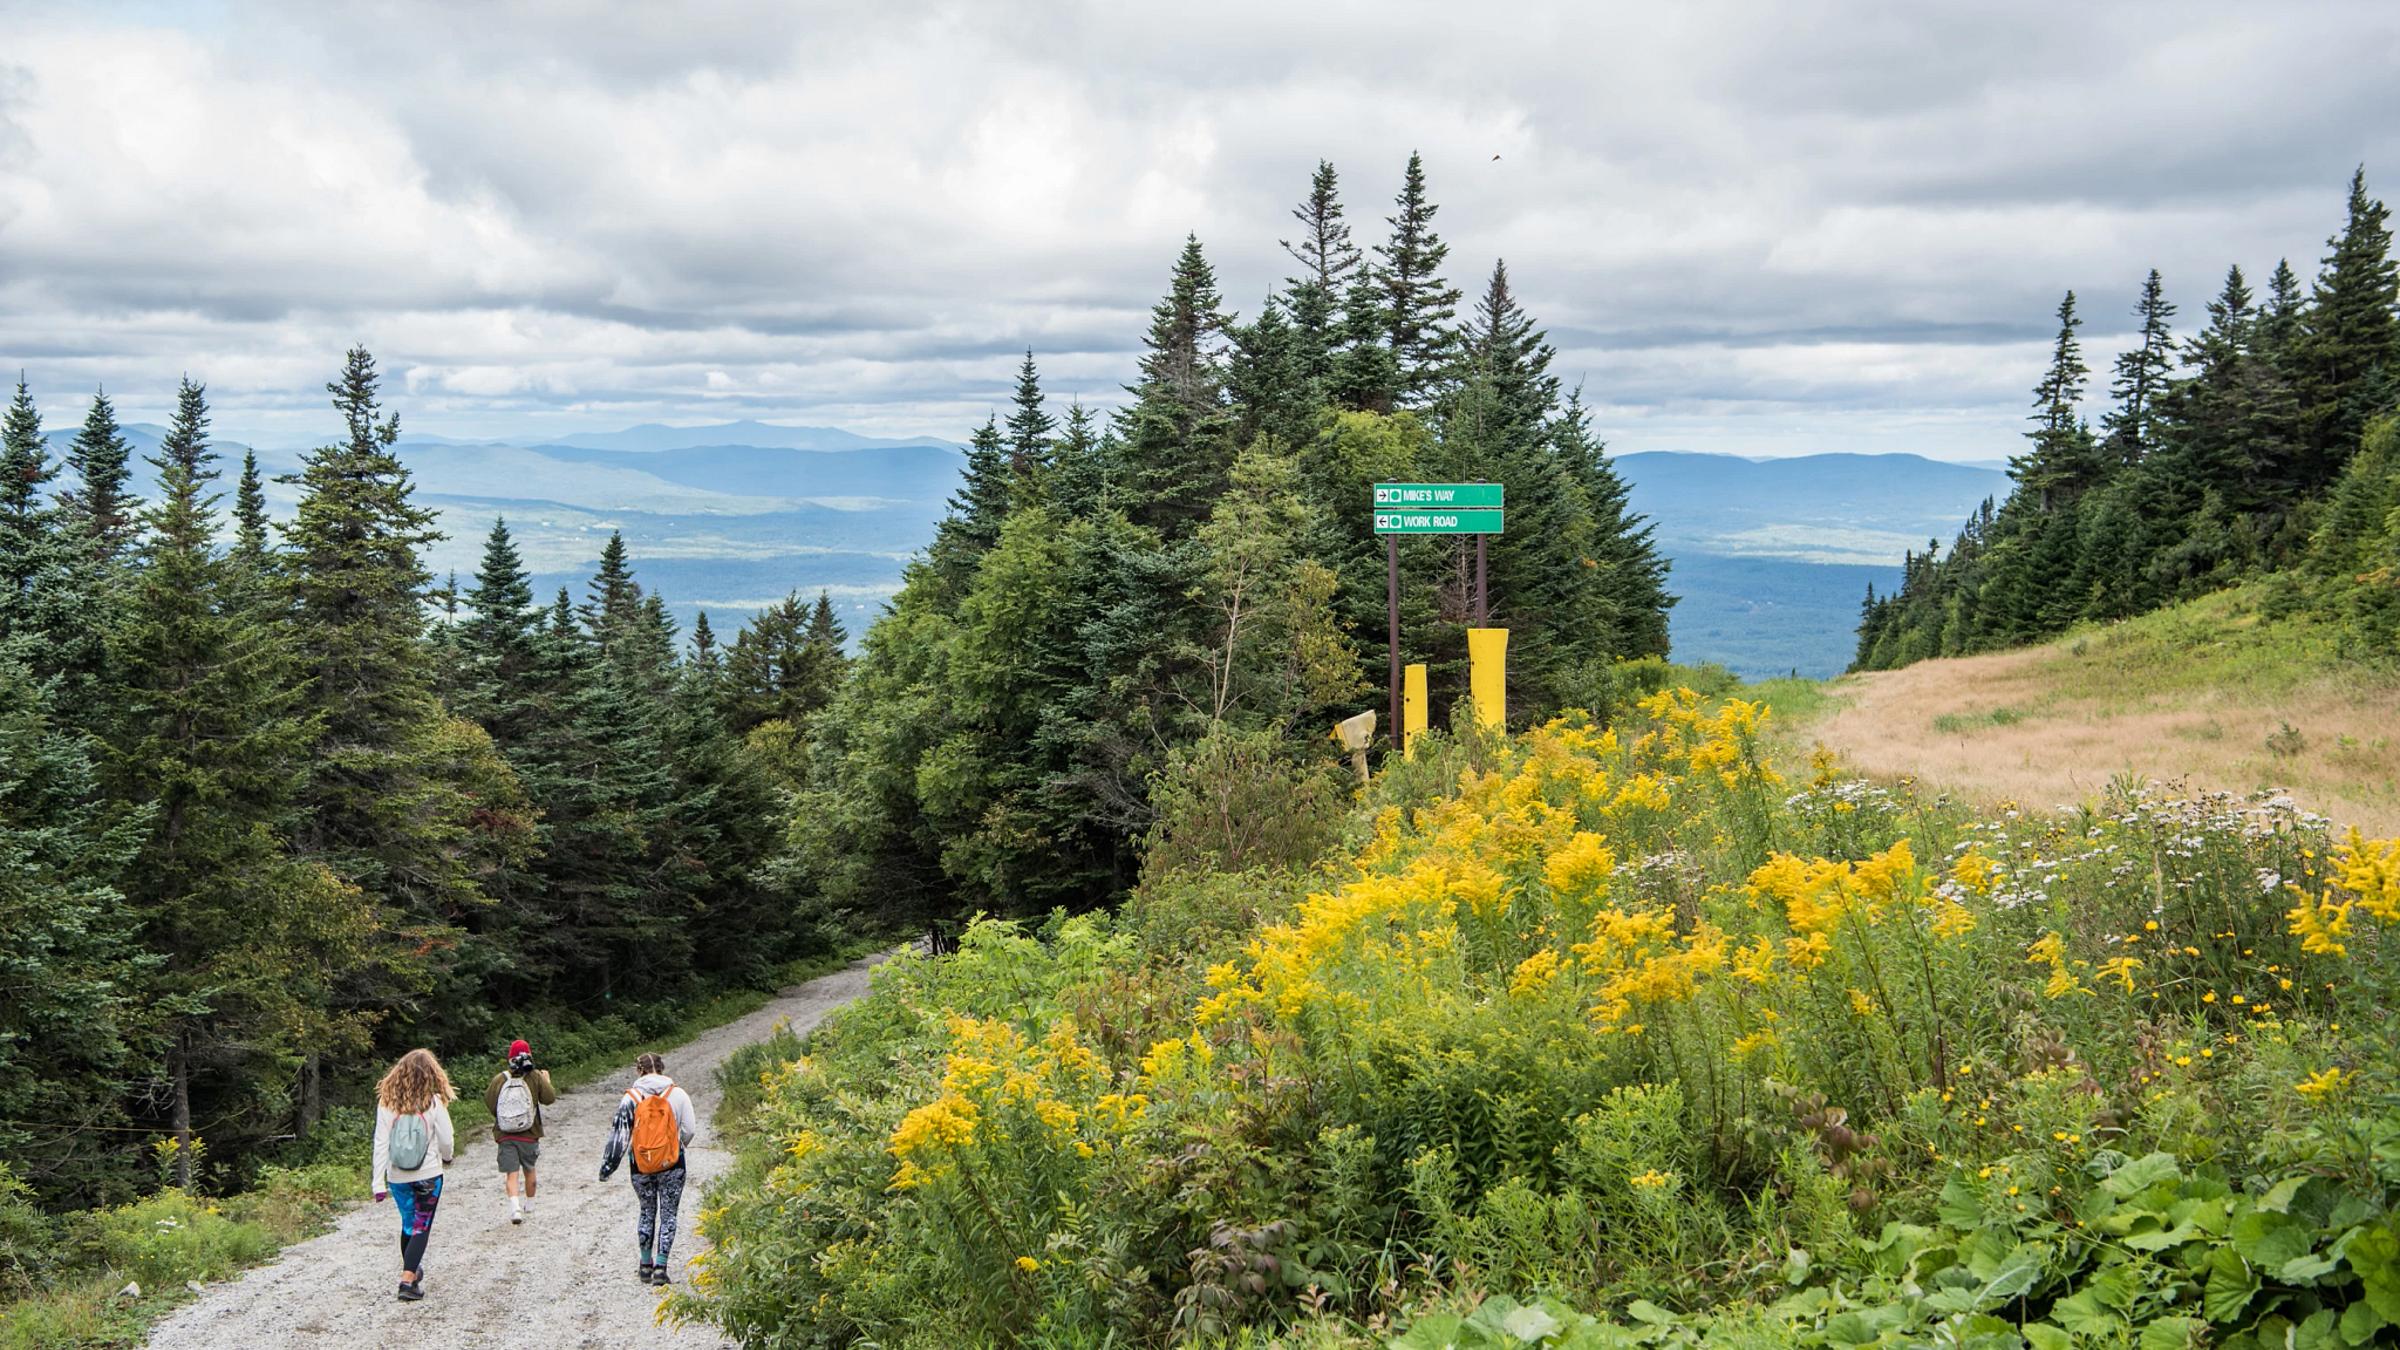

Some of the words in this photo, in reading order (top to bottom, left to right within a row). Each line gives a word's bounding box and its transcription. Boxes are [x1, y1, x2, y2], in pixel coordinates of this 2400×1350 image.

[1403, 490, 1432, 501] MIKE'S
[1434, 490, 1455, 501] WAY
[1404, 516, 1431, 527] WORK
[1433, 516, 1458, 527] ROAD
